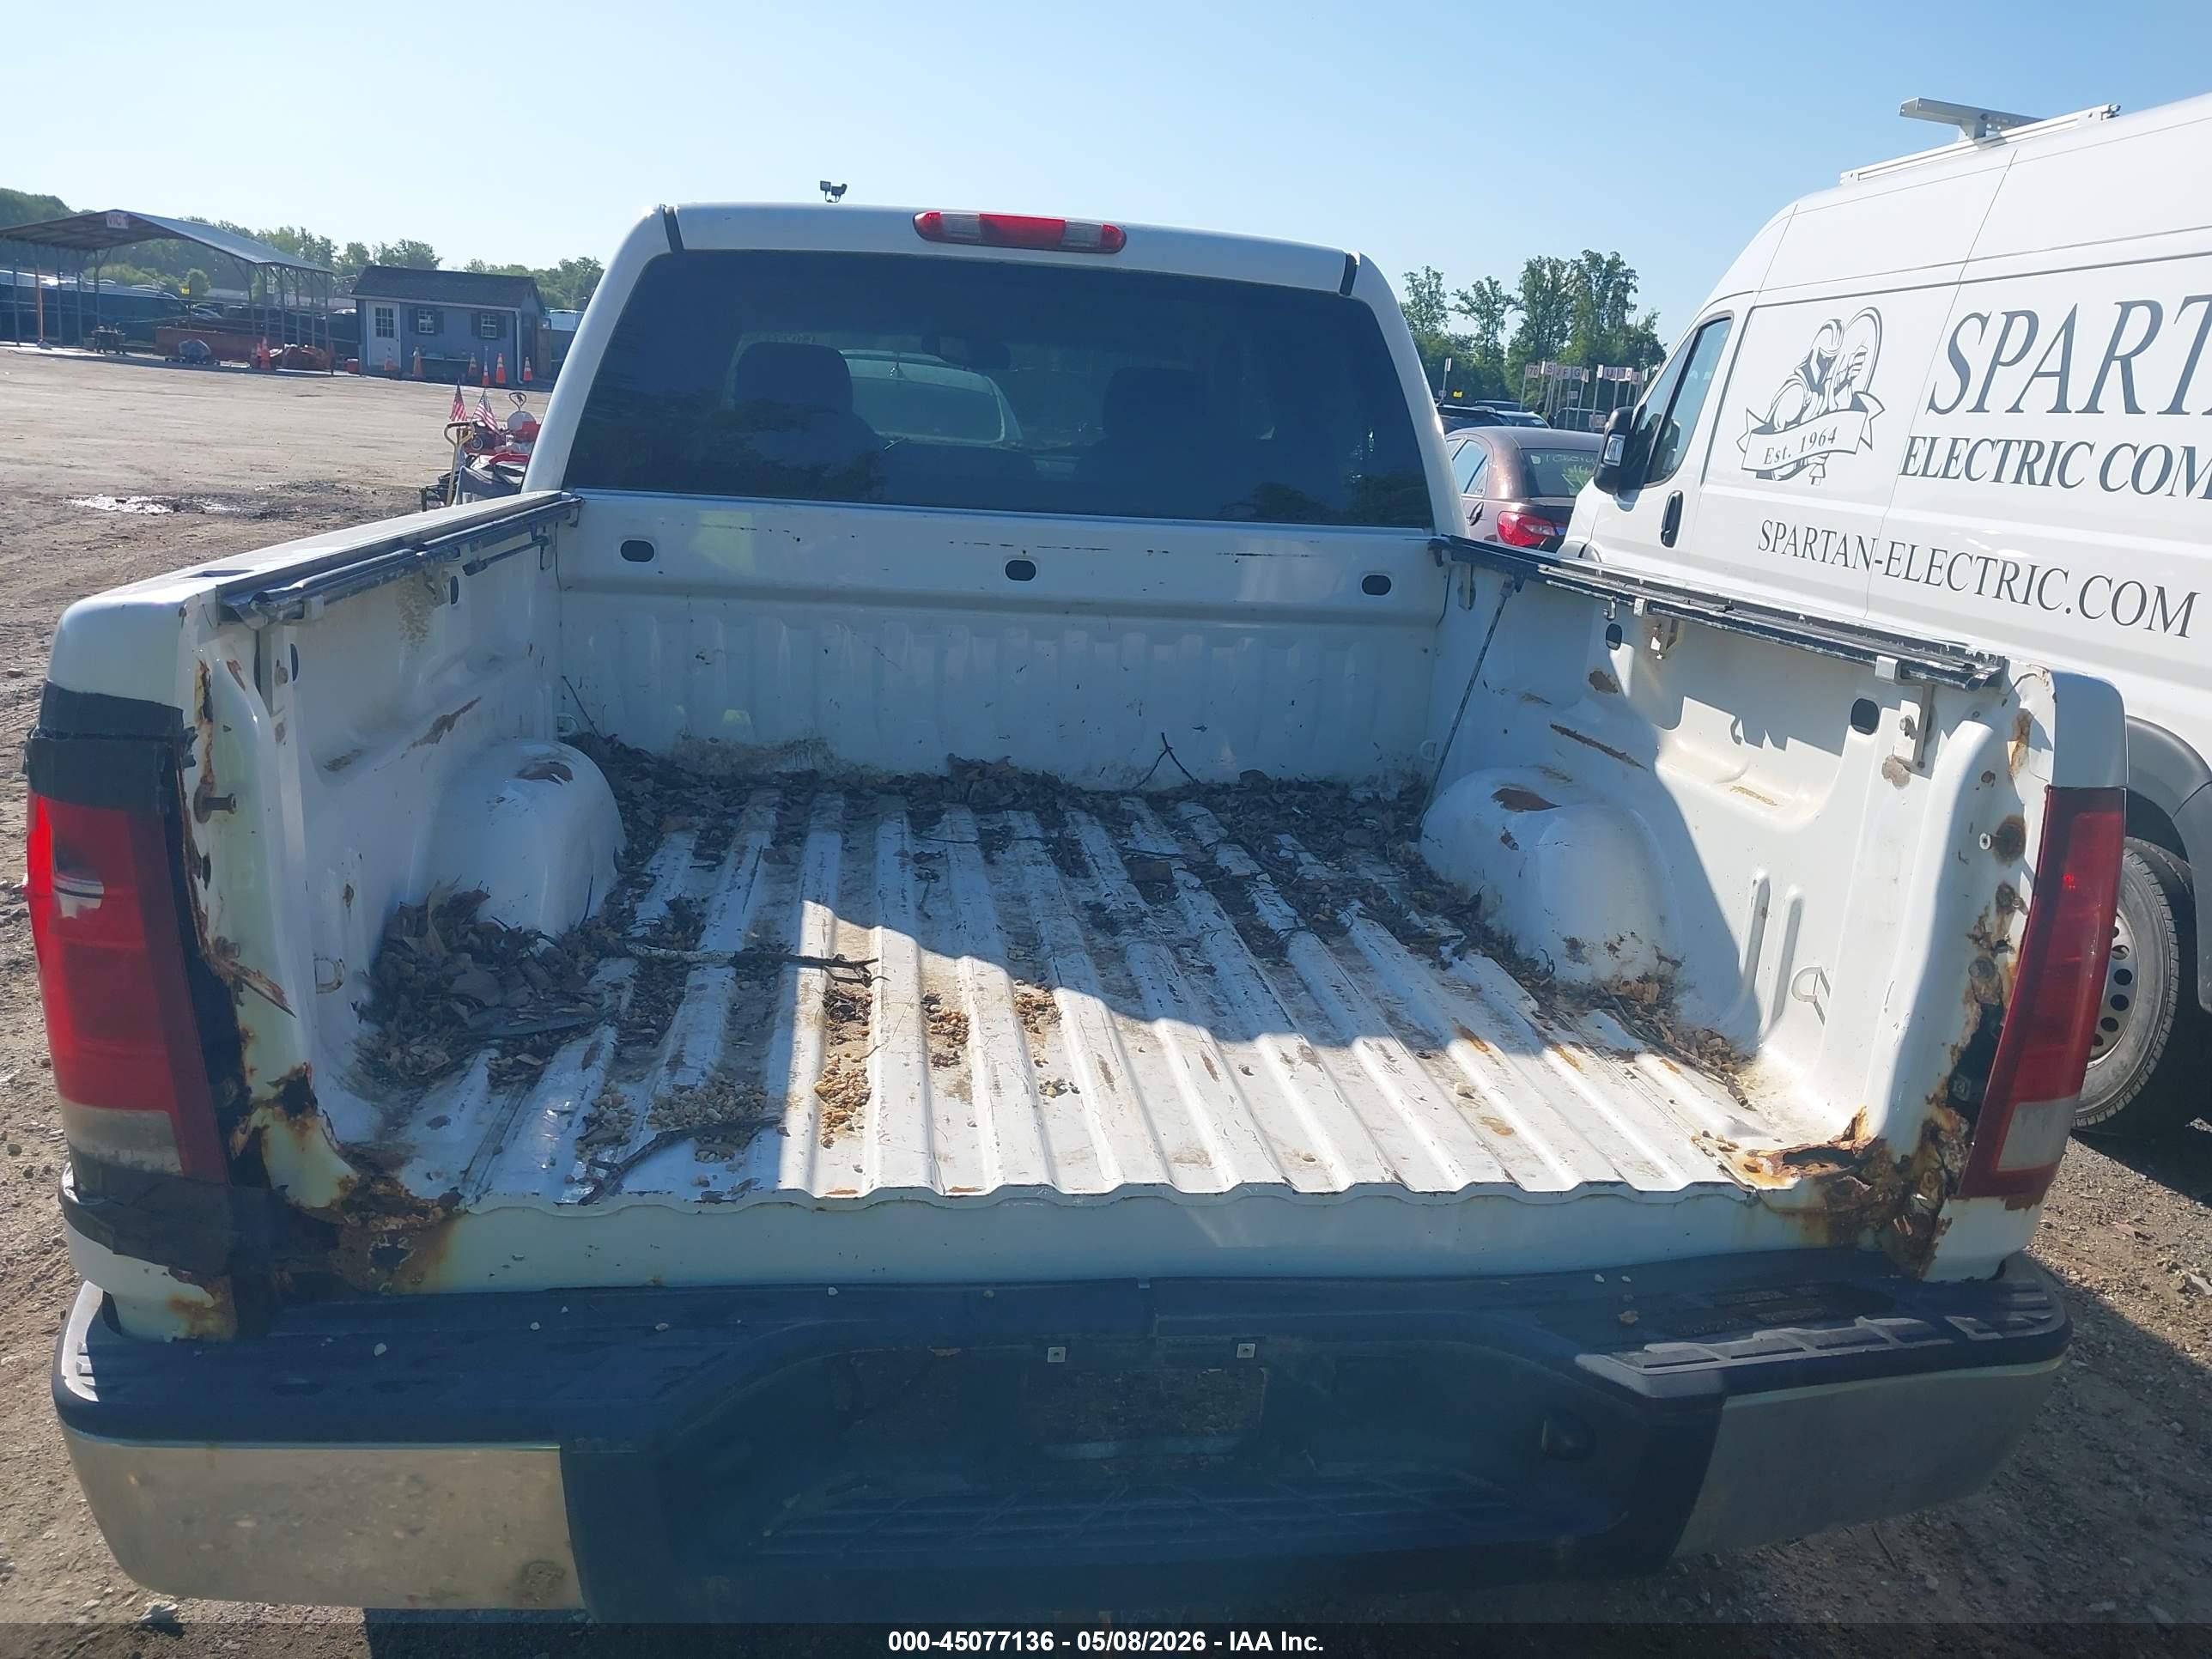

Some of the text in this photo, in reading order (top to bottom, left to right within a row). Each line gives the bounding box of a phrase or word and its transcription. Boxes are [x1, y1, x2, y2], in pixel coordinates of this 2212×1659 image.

[1926, 294, 2212, 416] SPART
[1764, 426, 1838, 465] Est. 1964
[1898, 435, 2096, 489] ELECTRIC
[1758, 519, 2202, 638] SPARTAN-ELECTRIC.COM
